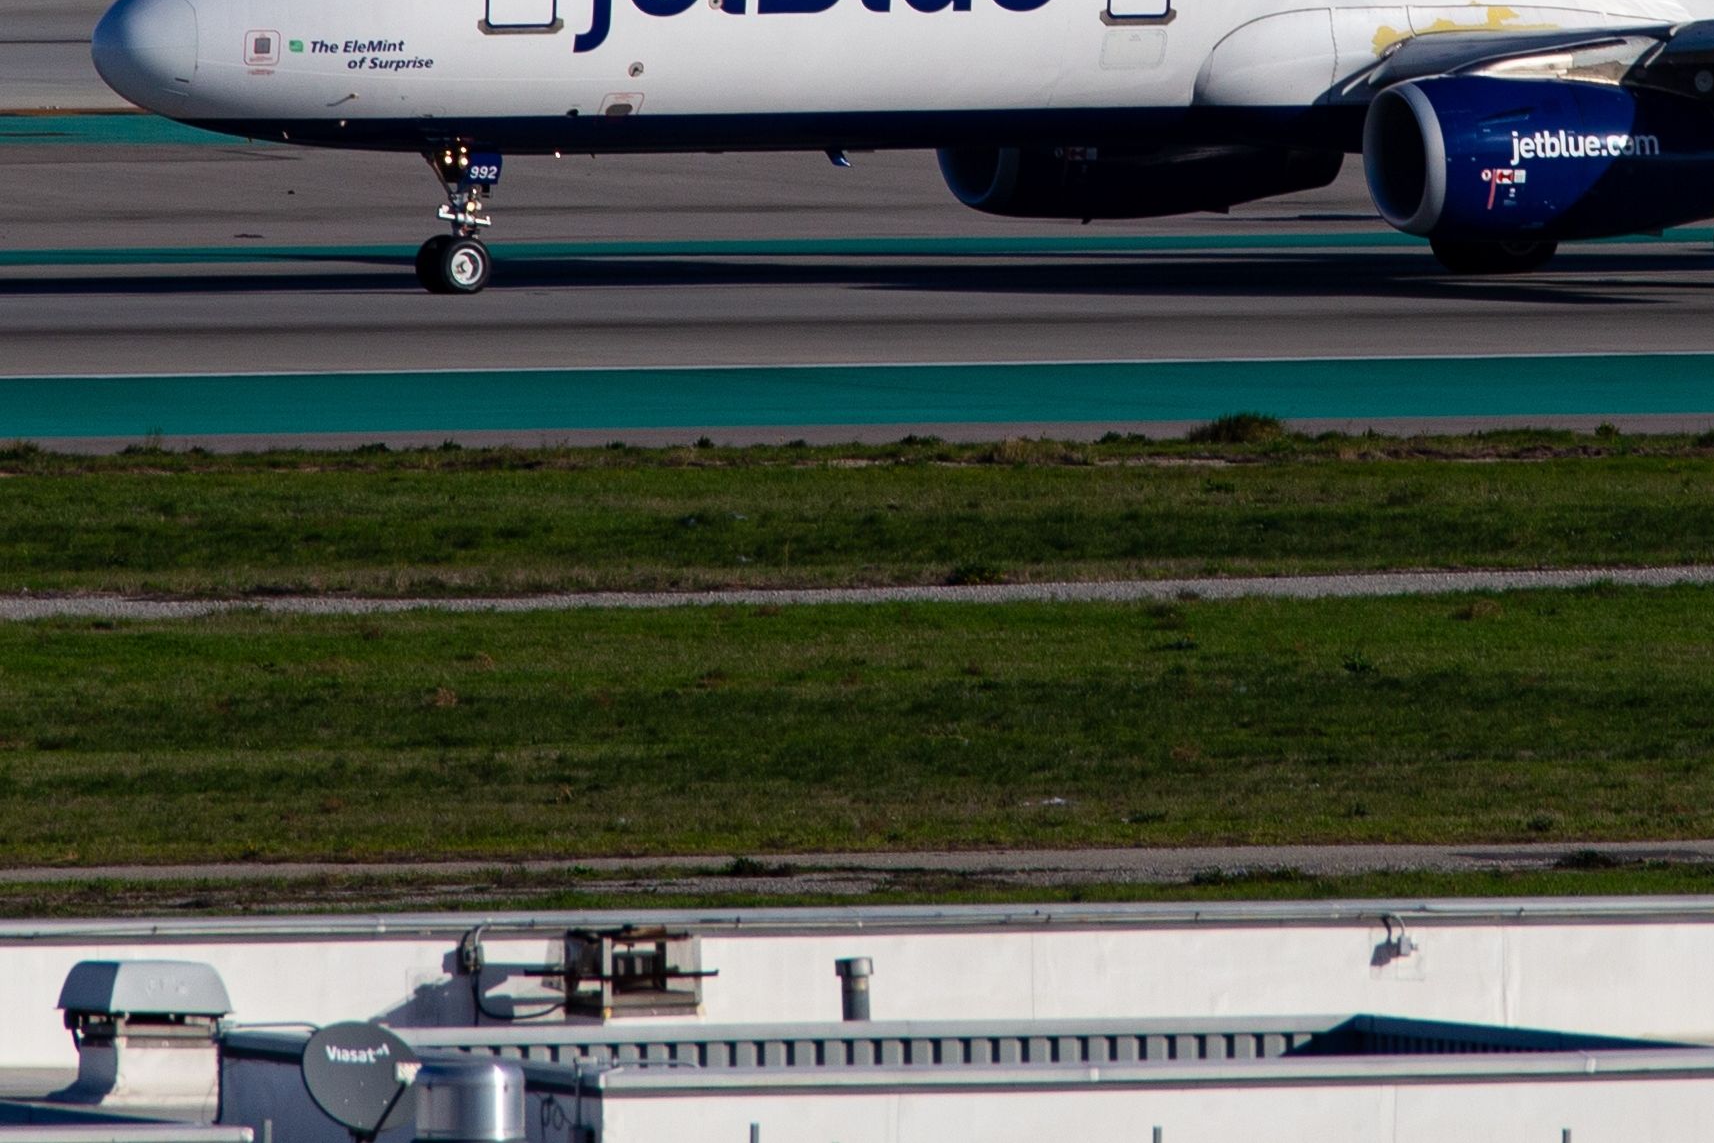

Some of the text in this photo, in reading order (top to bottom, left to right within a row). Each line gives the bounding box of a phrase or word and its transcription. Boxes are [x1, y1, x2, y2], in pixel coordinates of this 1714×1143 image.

[311, 39, 405, 53] The EleMint
[347, 57, 434, 72] of Surprise
[1510, 130, 1660, 166] jetblue.com
[470, 166, 498, 179] 992
[325, 1045, 377, 1064] Viasat
